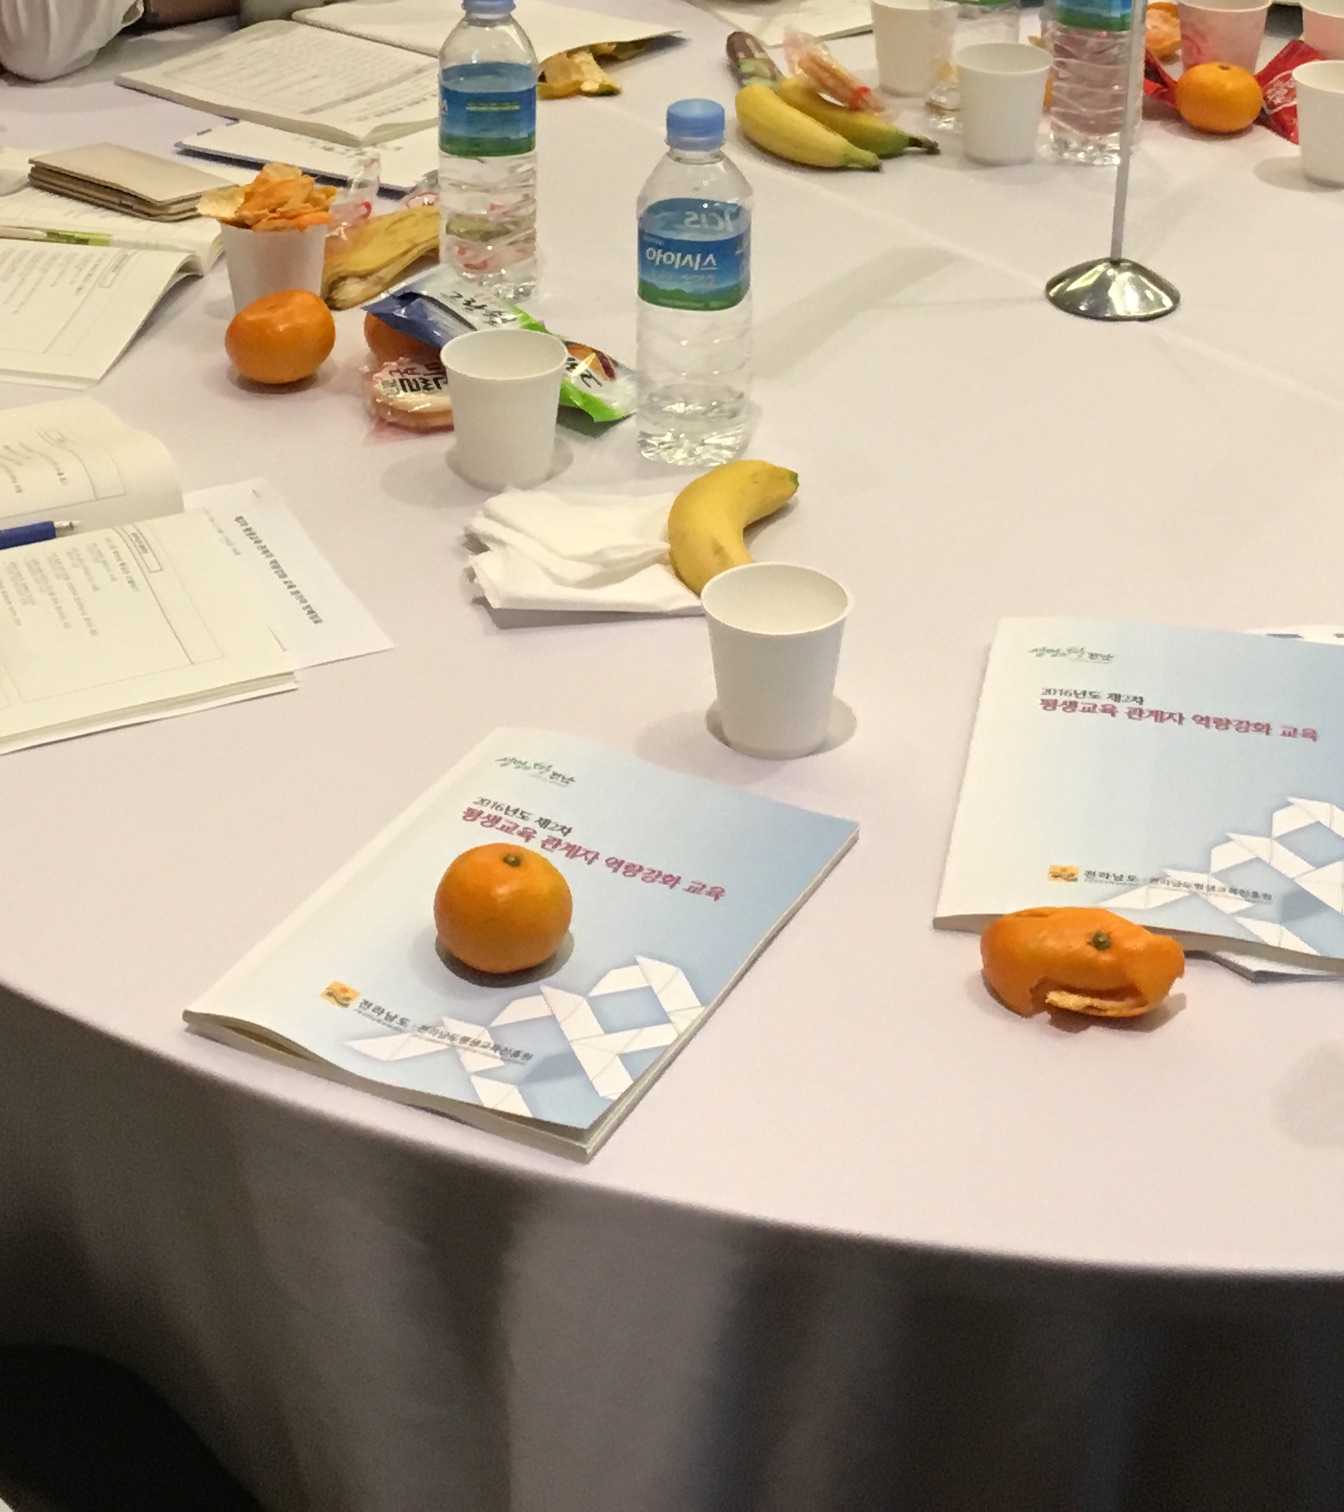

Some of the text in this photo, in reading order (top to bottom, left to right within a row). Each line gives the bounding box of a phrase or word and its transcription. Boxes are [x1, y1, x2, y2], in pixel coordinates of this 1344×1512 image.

[645, 247, 718, 270] 아이시스
[1041, 687, 1144, 706] 2016년도 제2차
[1040, 698, 1318, 742] 평생교육 관계자 역량강화 교육
[472, 796, 573, 838] 2016년도 제2차
[462, 806, 726, 902] 평생교육 관계자 역량강화 교육
